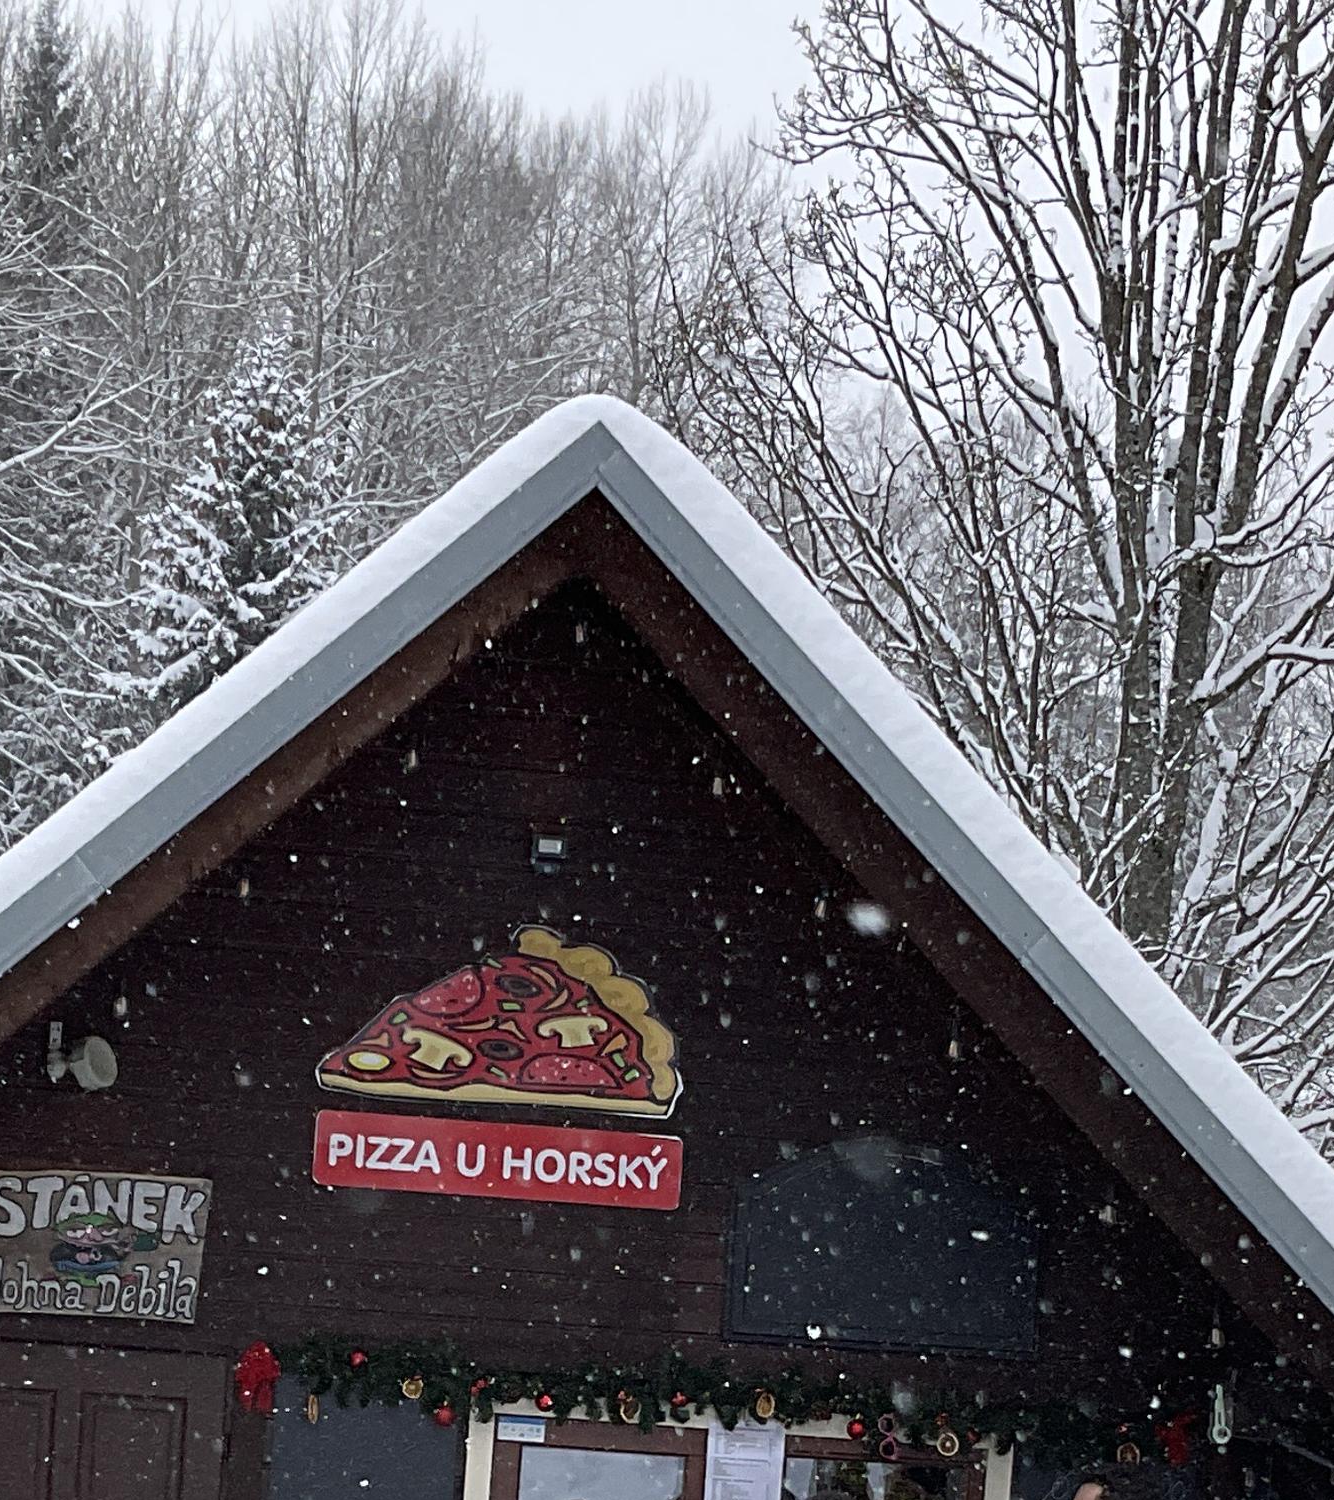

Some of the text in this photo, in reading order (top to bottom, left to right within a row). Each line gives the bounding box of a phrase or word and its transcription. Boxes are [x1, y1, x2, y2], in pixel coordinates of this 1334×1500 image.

[327, 1132, 669, 1192] PIZZA U HORSKÝ
[94, 1258, 198, 1320] Debila
